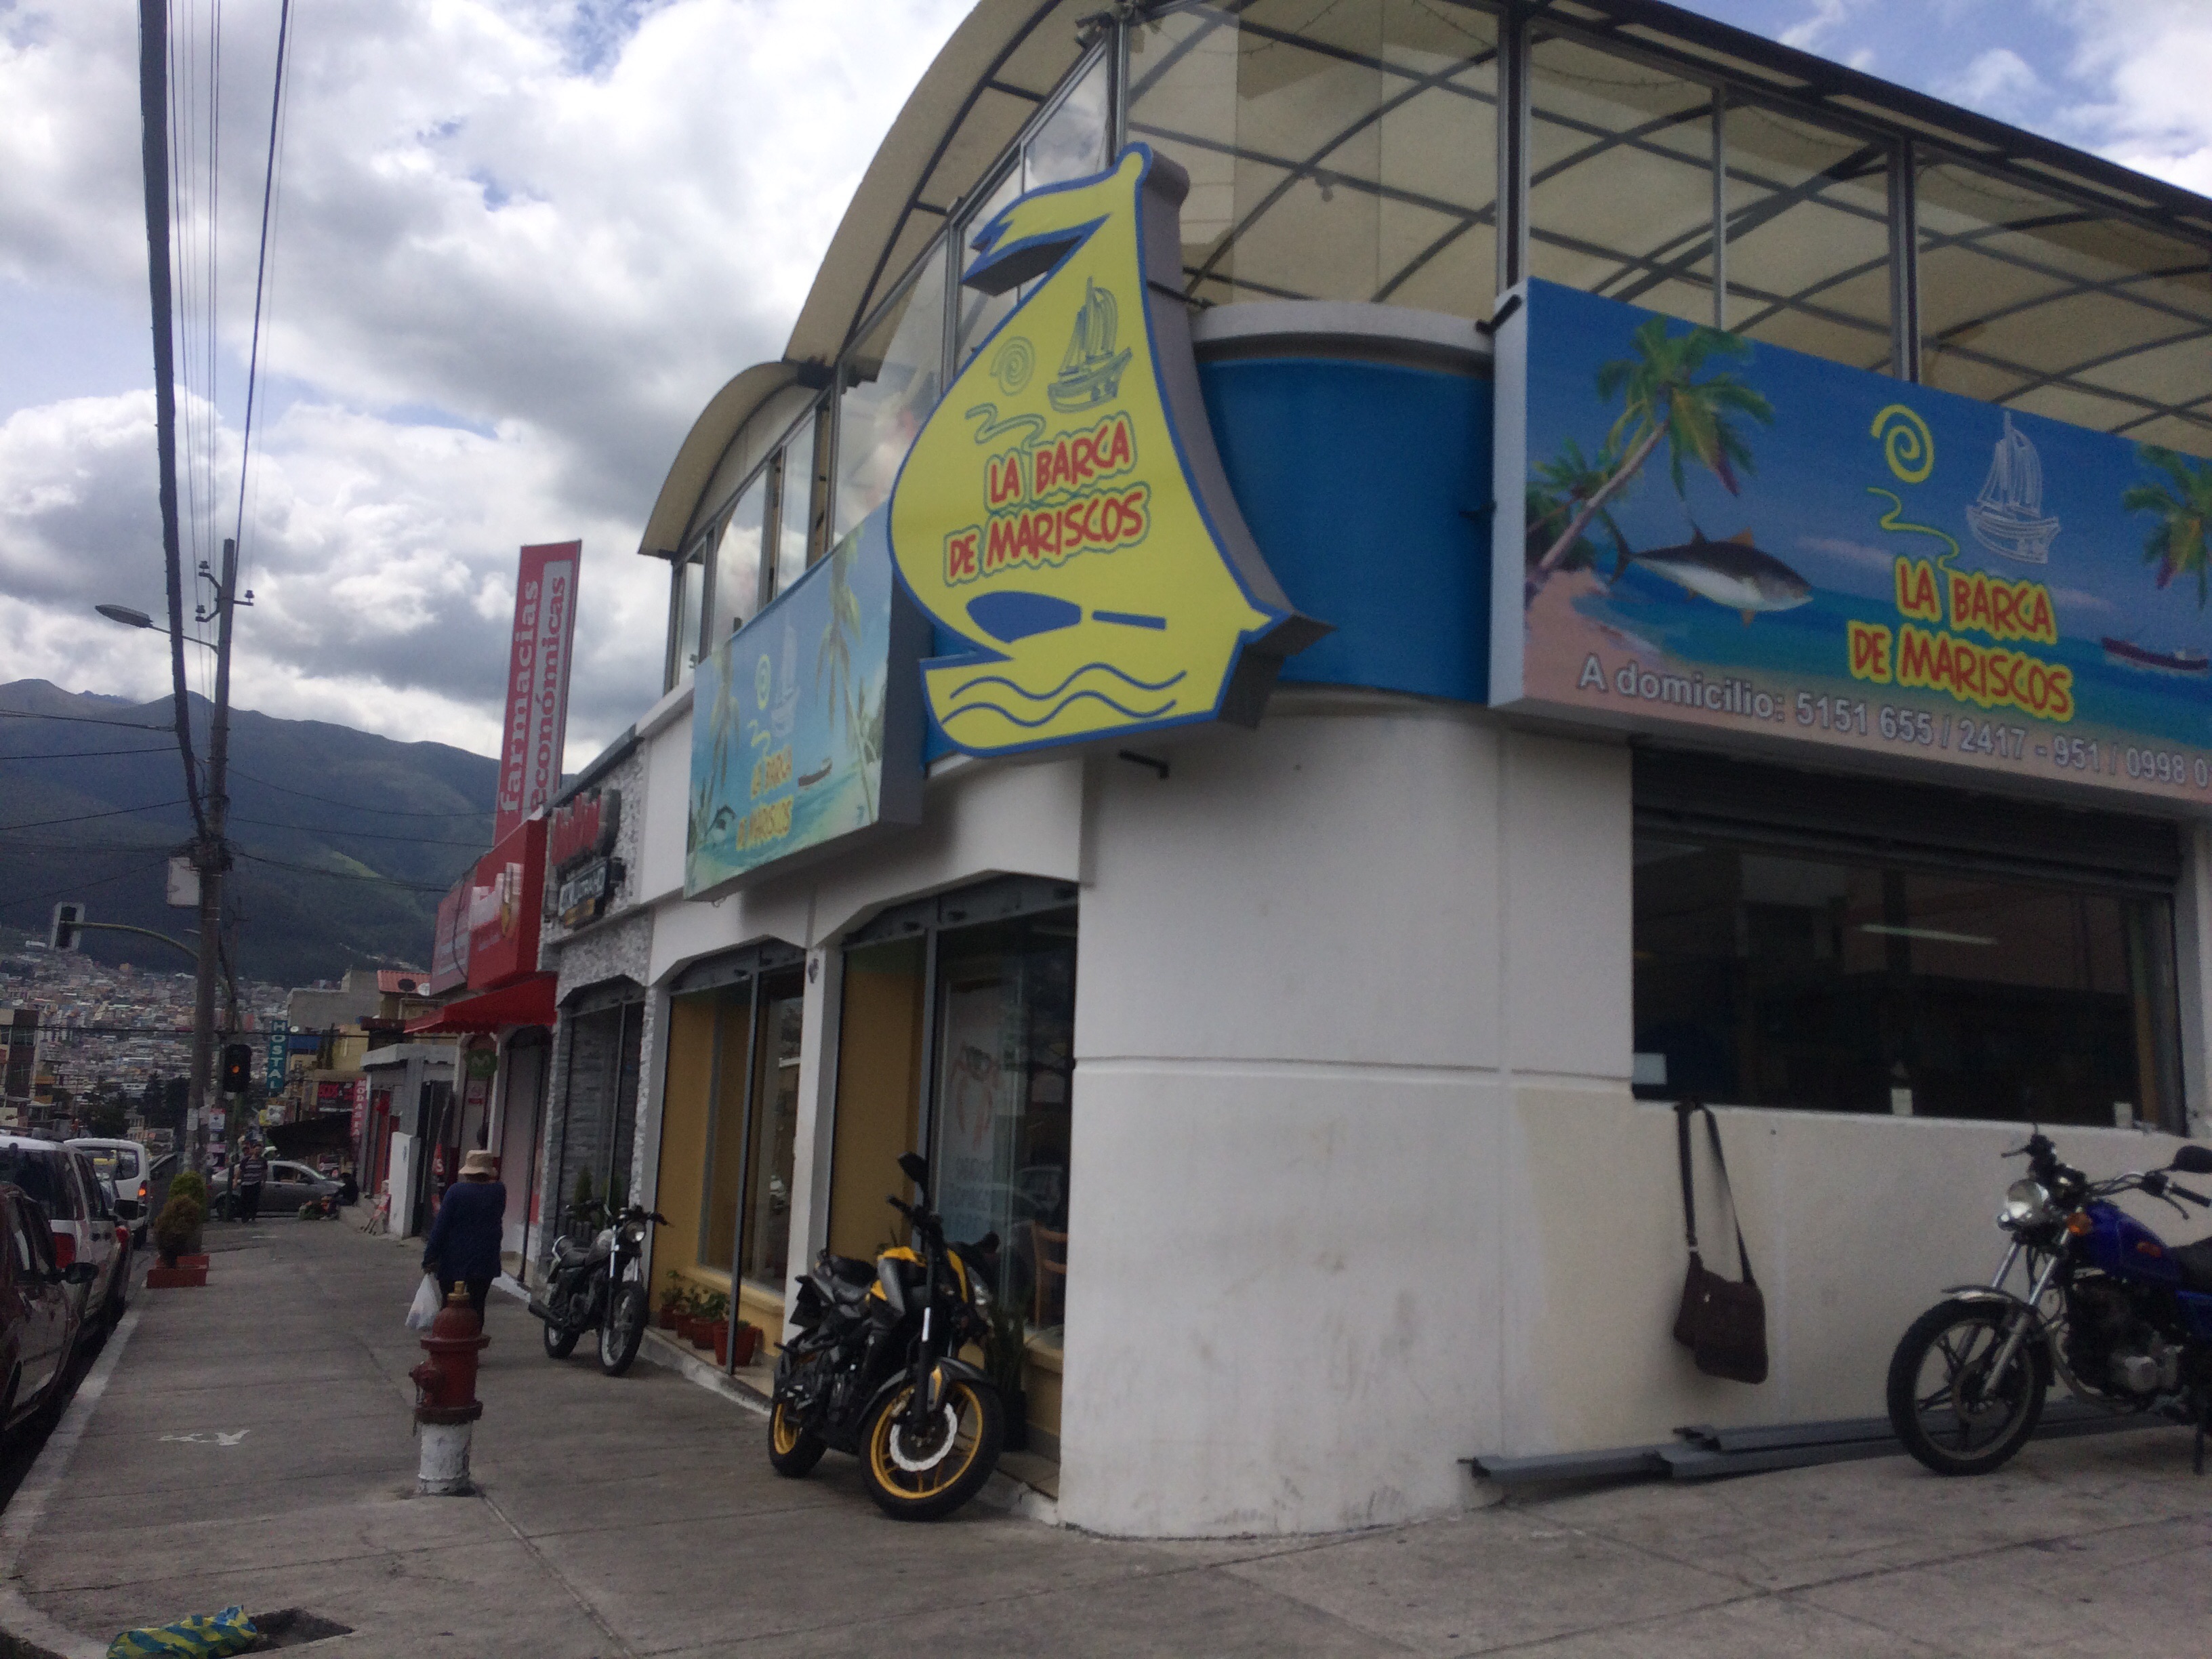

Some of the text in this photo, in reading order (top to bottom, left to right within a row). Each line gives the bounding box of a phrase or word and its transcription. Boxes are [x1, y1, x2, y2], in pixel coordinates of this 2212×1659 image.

[990, 420, 1130, 504] LA BARCA
[950, 491, 1143, 577] DE MARISCOS
[1900, 562, 2053, 636] LA BARCA
[499, 579, 538, 813] farmacias
[530, 575, 565, 813] económicas
[1853, 628, 2070, 714] DE MARISCOS
[1577, 652, 1610, 693] A
[1615, 659, 1785, 724] domicilio:
[1795, 691, 1869, 737] 5151
[1879, 705, 1933, 745] 655
[1959, 718, 2027, 760] 2417
[2053, 735, 2101, 773] 951
[2125, 746, 2187, 785] 0998
[2194, 757, 2212, 788] 0
[268, 1021, 286, 1090] HOSTAL
